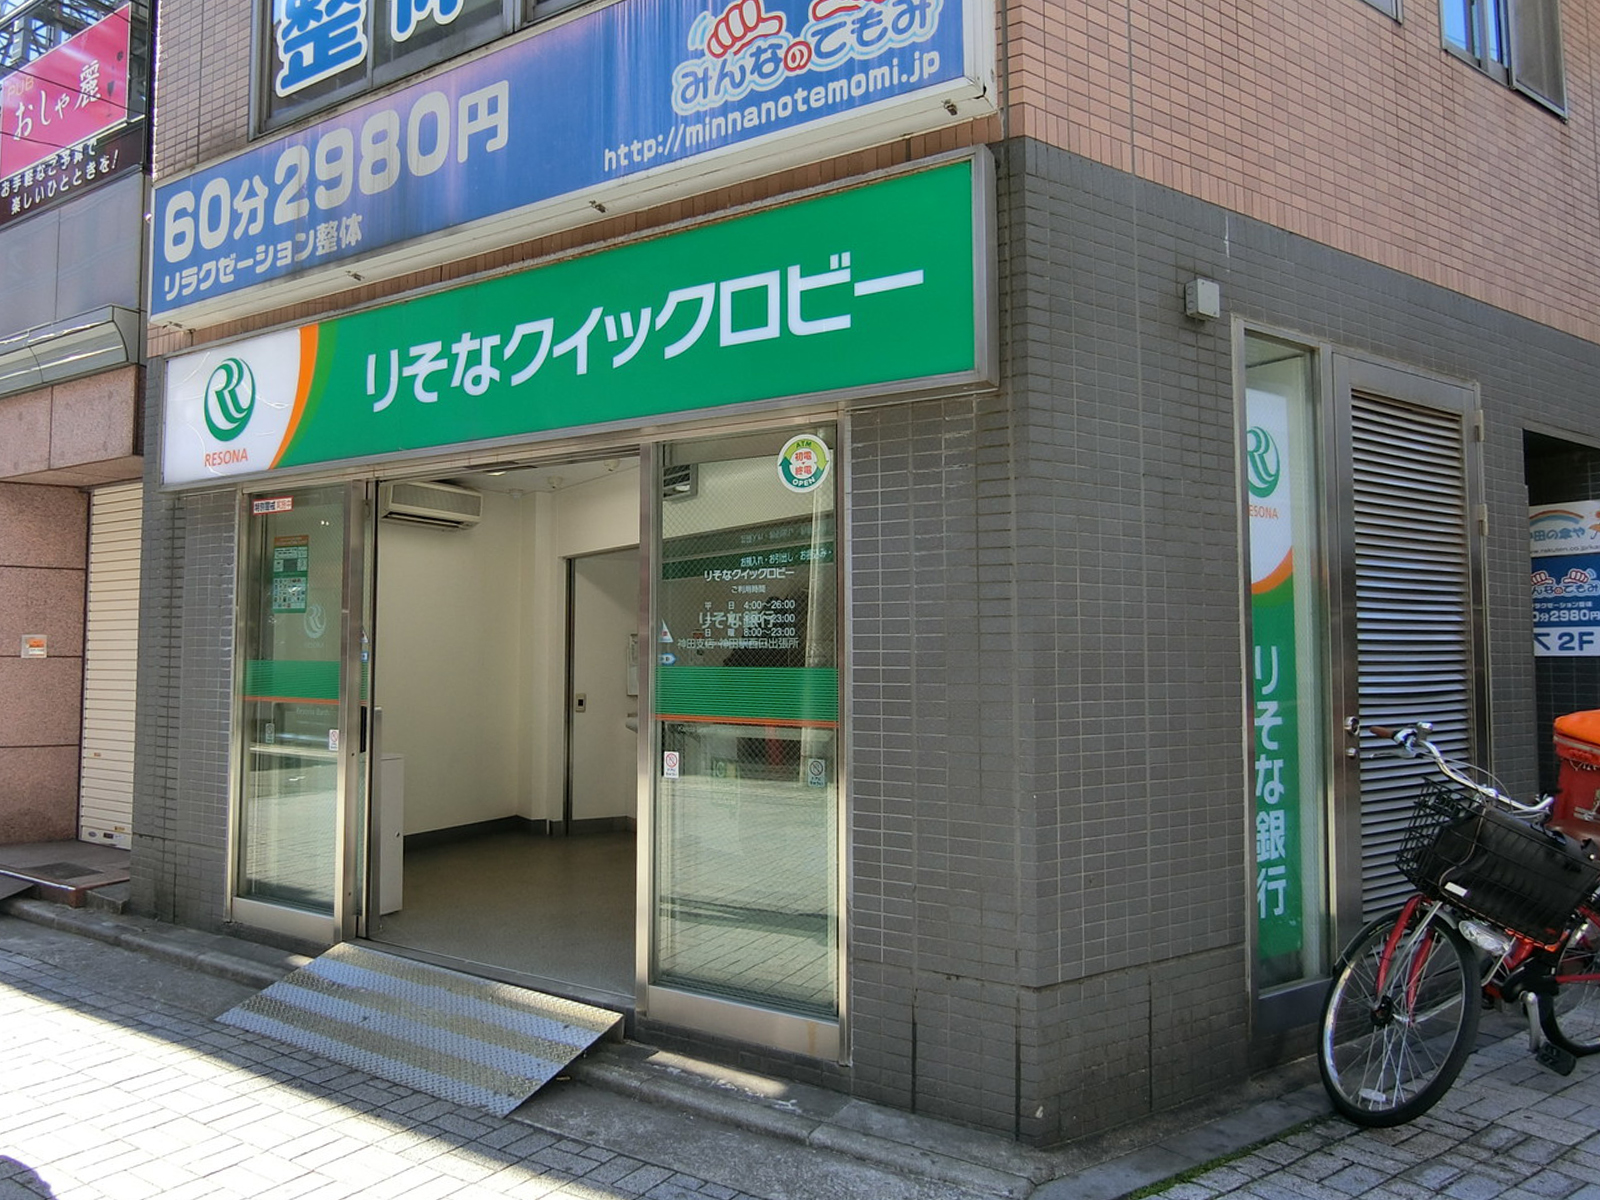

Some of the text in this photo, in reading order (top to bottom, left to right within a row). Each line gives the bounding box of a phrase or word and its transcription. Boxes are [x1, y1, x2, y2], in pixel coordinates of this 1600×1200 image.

[8, 77, 35, 98] PUB
[680, 0, 932, 103] みんなのてもみ
[13, 60, 101, 140] おしゃ麗
[604, 51, 940, 172] http://minnanotemomi.jp
[164, 80, 509, 263] 60分2980円
[164, 213, 363, 301] リラクゼーション整体
[366, 251, 925, 413] りそなクイックロビー
[204, 448, 248, 467] RESONA
[792, 476, 815, 487] OPEN
[796, 440, 812, 448] ATM
[1557, 632, 1595, 651] 2F
[1254, 645, 1287, 919] りそな銀行
